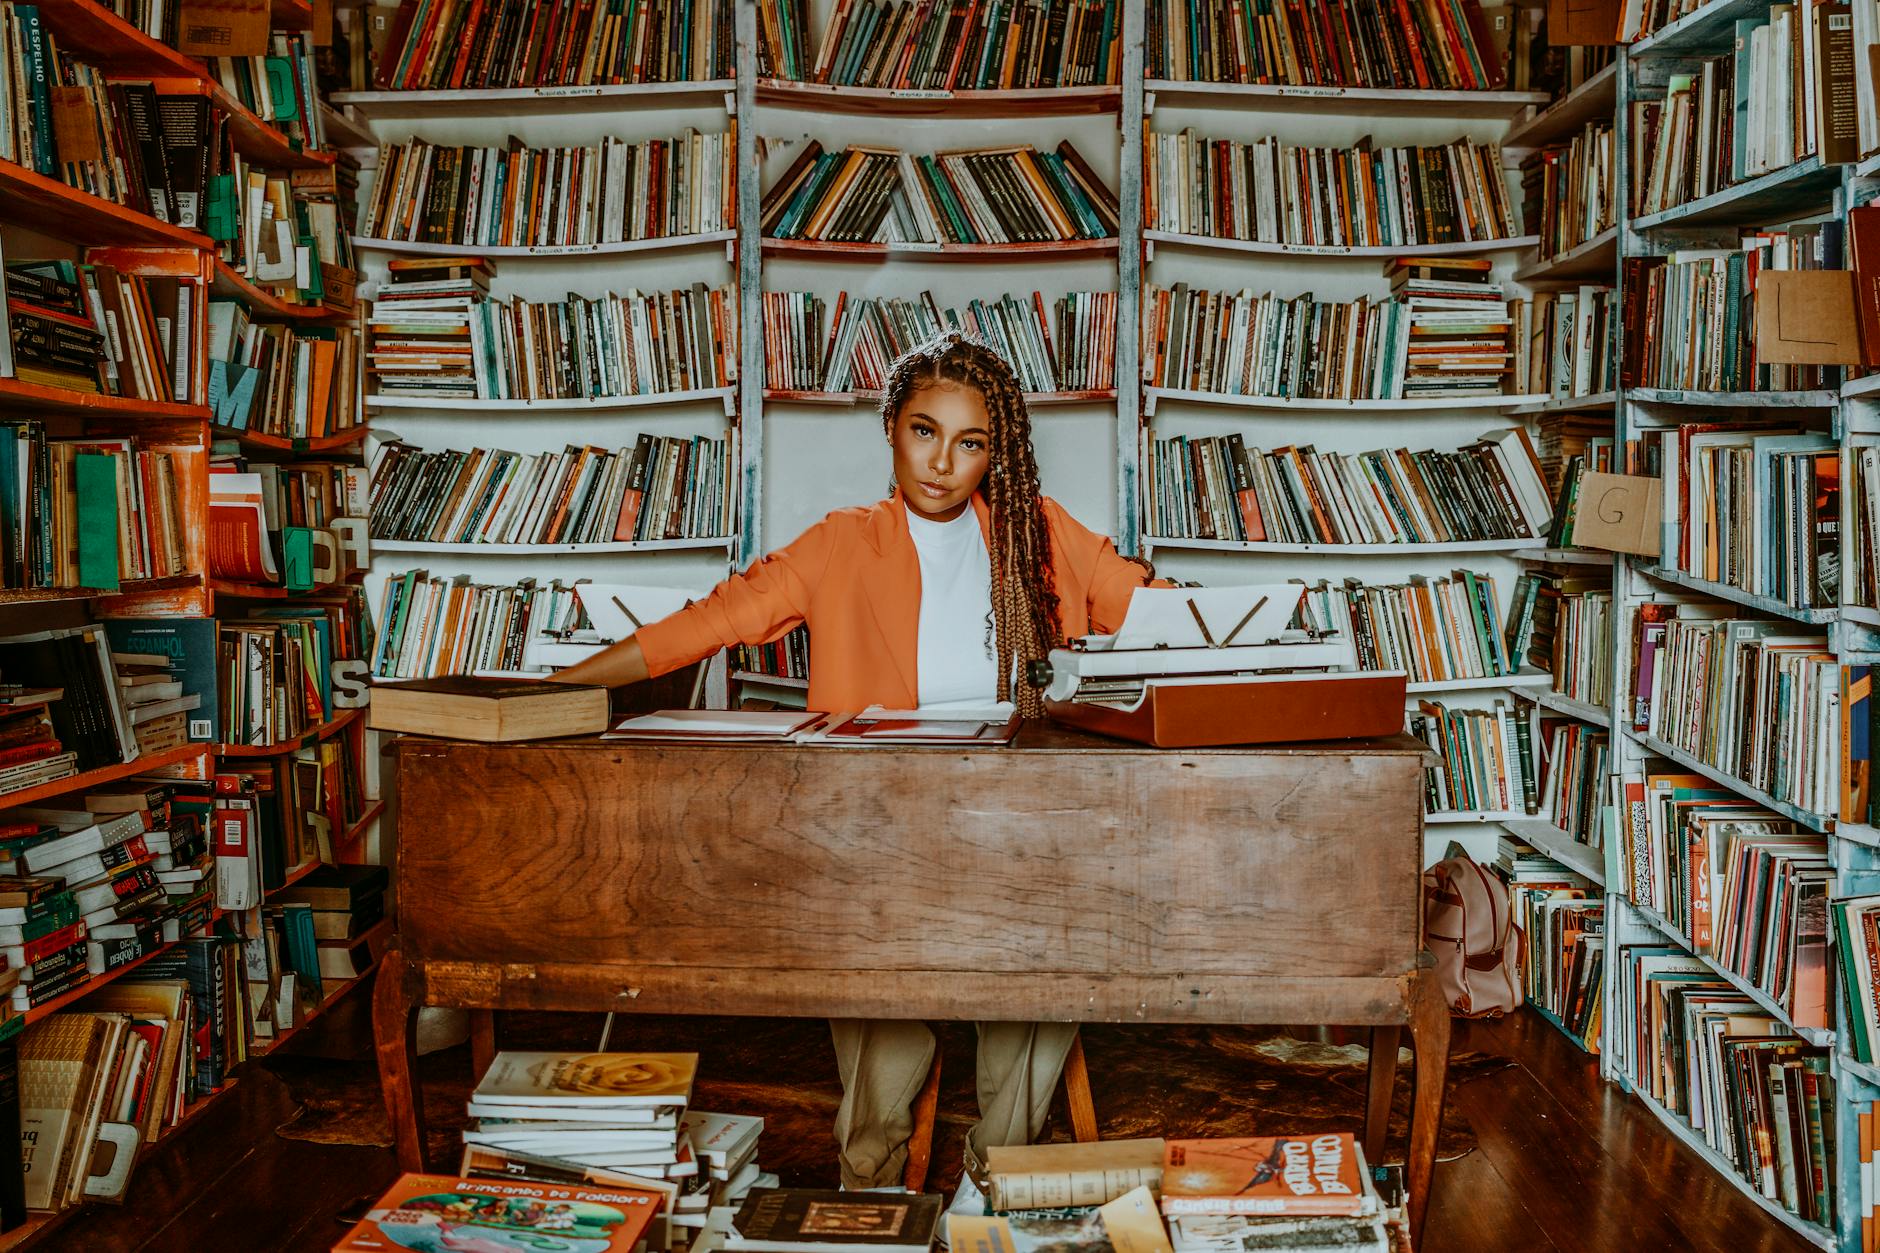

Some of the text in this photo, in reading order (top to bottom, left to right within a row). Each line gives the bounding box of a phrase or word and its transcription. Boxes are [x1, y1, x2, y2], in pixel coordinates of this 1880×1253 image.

[30, 17, 44, 83] O ESPELHO
[1598, 486, 1629, 524] G
[1816, 521, 1836, 534] O QUE
[127, 636, 185, 659] ESPANHOL
[331, 660, 370, 708] S
[213, 944, 223, 1038] Collins
